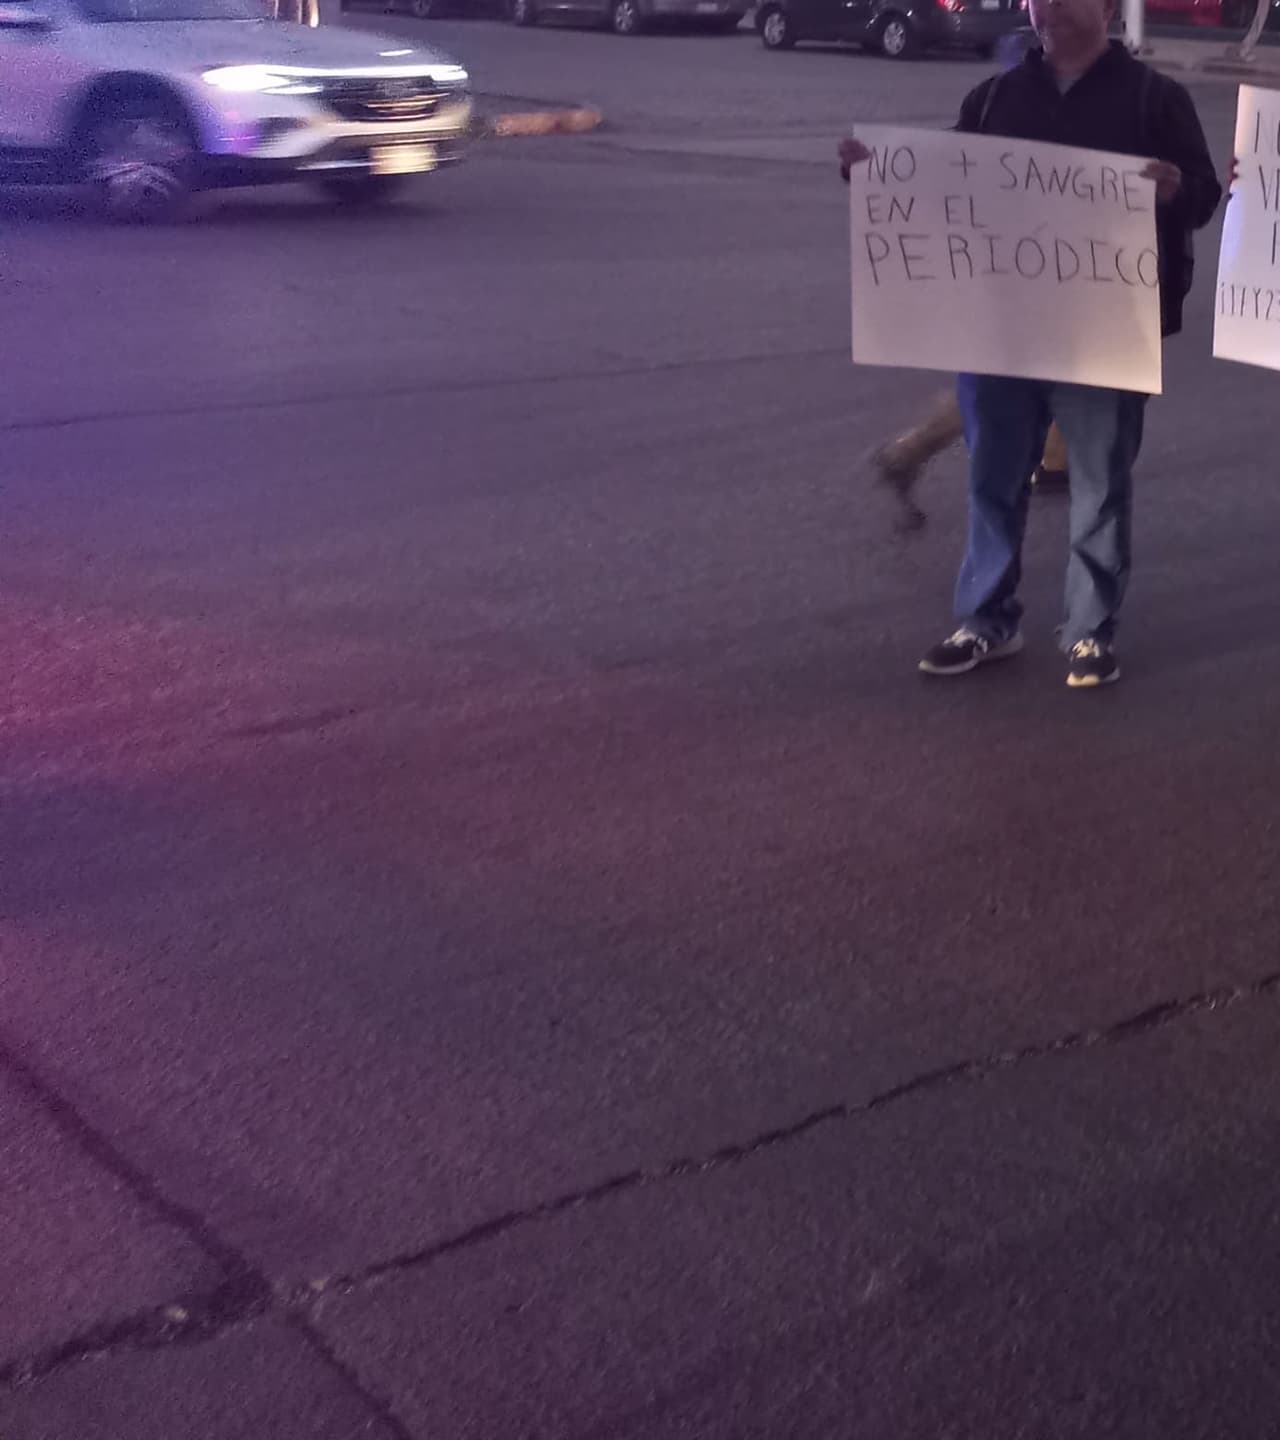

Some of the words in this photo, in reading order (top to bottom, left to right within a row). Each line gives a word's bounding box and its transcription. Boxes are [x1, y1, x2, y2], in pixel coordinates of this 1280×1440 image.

[867, 145, 917, 185] NO
[999, 151, 1150, 212] SANGRE
[865, 194, 915, 225] EN
[944, 195, 988, 229] EL
